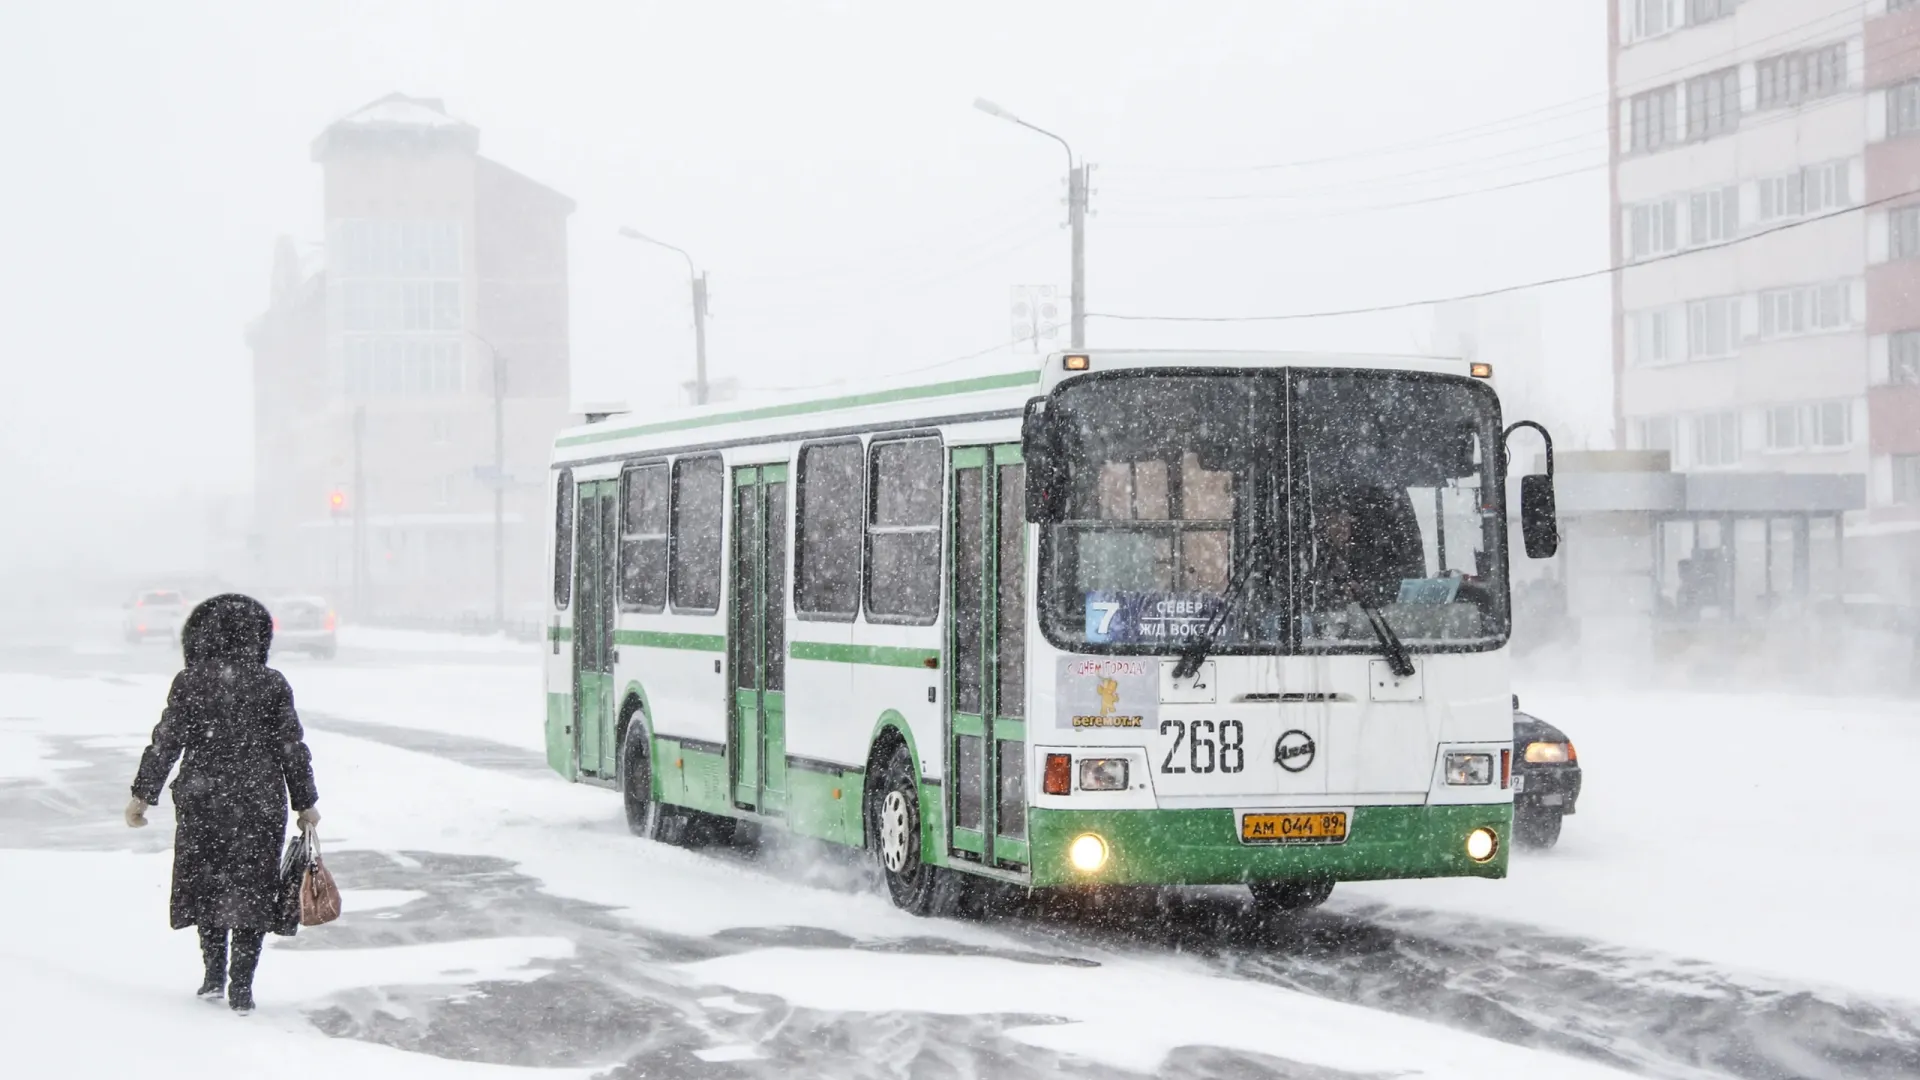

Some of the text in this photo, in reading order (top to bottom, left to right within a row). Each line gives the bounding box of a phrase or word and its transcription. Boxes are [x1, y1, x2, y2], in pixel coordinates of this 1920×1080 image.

[1156, 601, 1203, 614] СЕВЕР
[1092, 602, 1120, 634] 7
[1139, 623, 1166, 637] Ж/Д
[1160, 719, 1244, 774] 268
[1252, 815, 1339, 835] АМ 044 89
